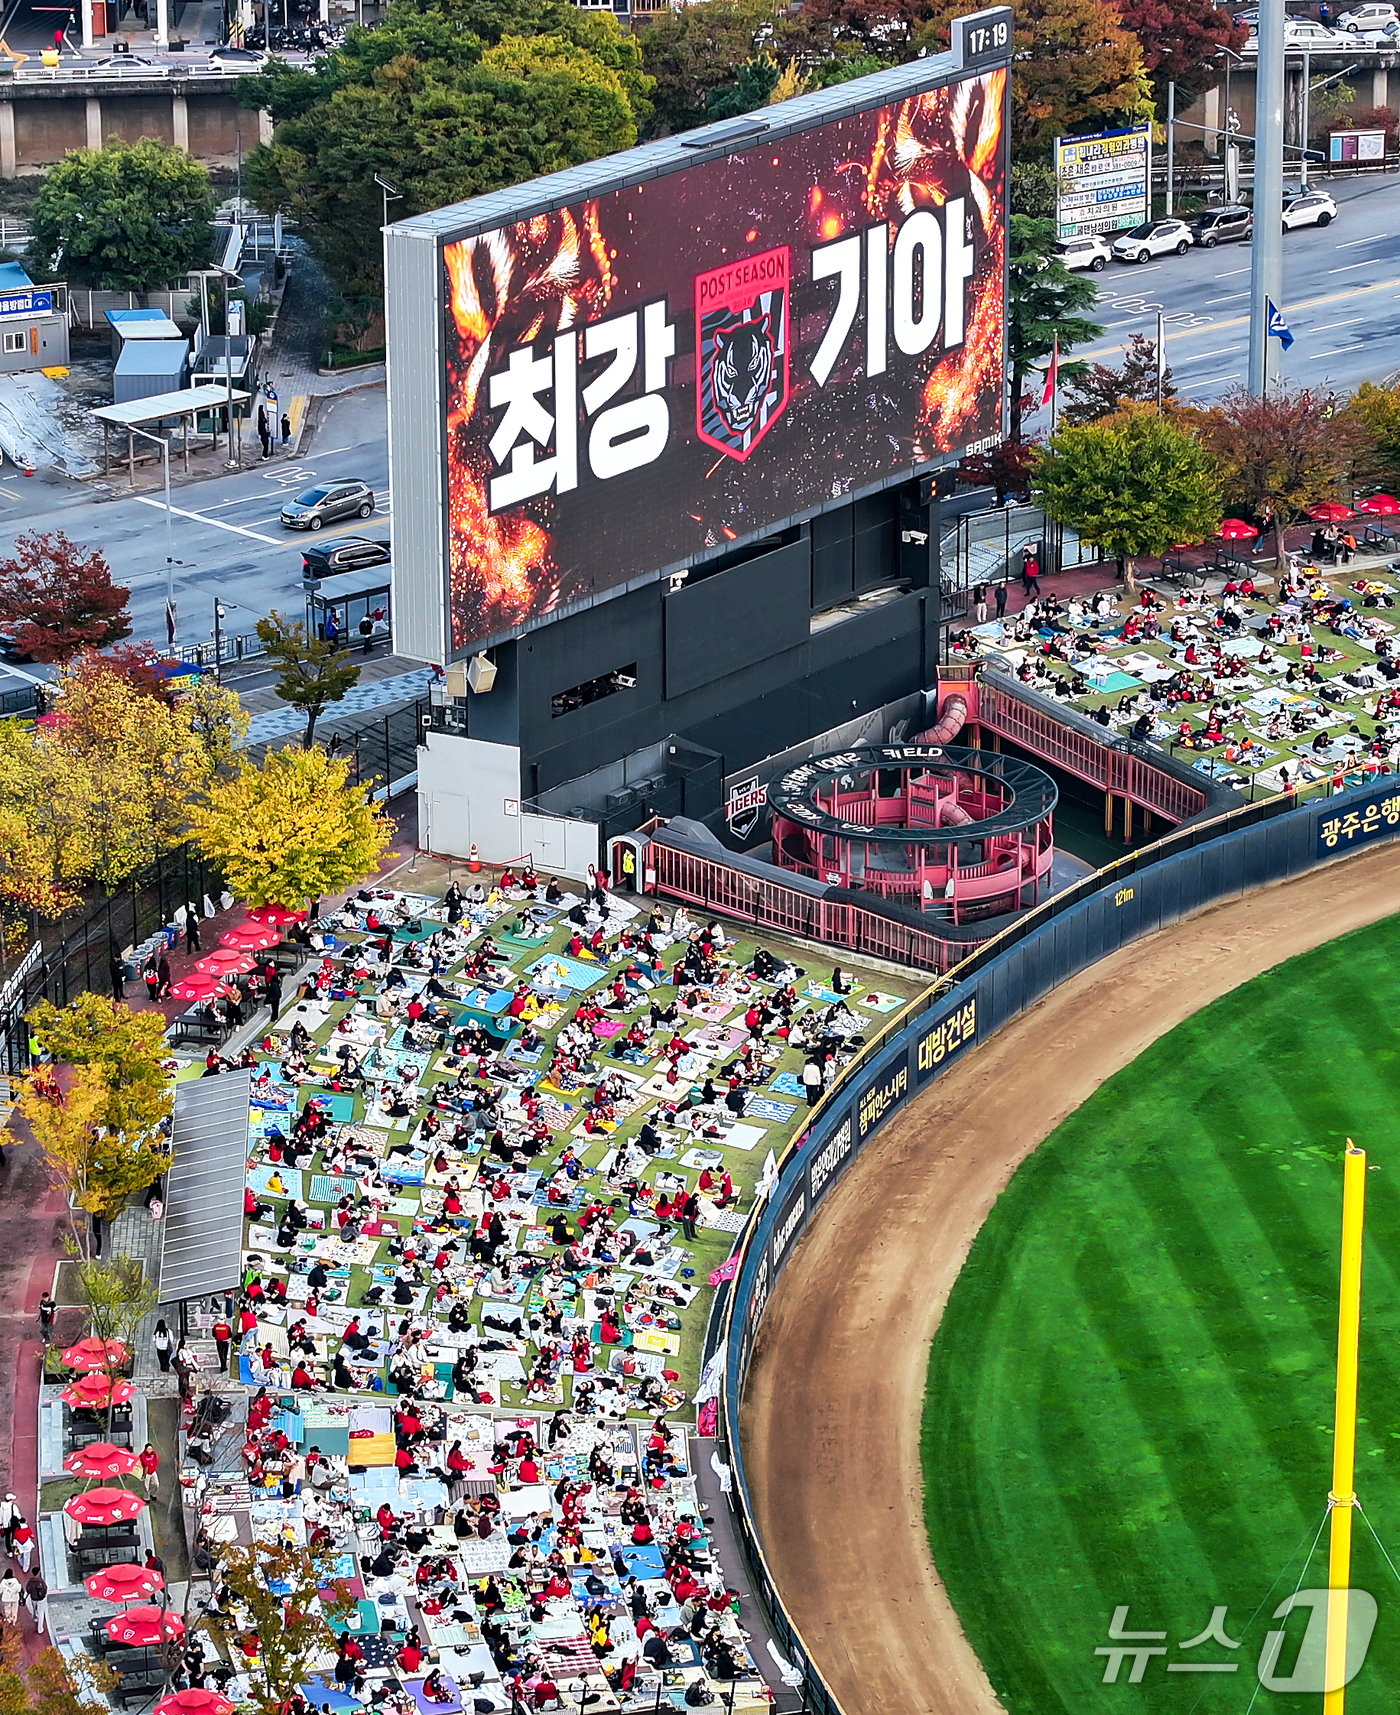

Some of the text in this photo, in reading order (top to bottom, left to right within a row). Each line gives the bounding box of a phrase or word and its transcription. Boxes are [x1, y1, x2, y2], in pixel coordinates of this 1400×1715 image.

[970, 22, 1008, 54] 17:19
[700, 271, 733, 306] POST
[735, 254, 785, 287] SEASON
[0, 298, 33, 315] 율방범대
[488, 196, 975, 513] 최강 기아
[965, 432, 1002, 457] SAMIK
[725, 783, 769, 821] TIGERS
[1320, 795, 1400, 848] 광주은행
[1114, 887, 1134, 908] 121m
[918, 998, 976, 1071] 대방건설
[859, 1065, 908, 1136] 챔피언스시티
[773, 1228, 786, 1267] bhc
